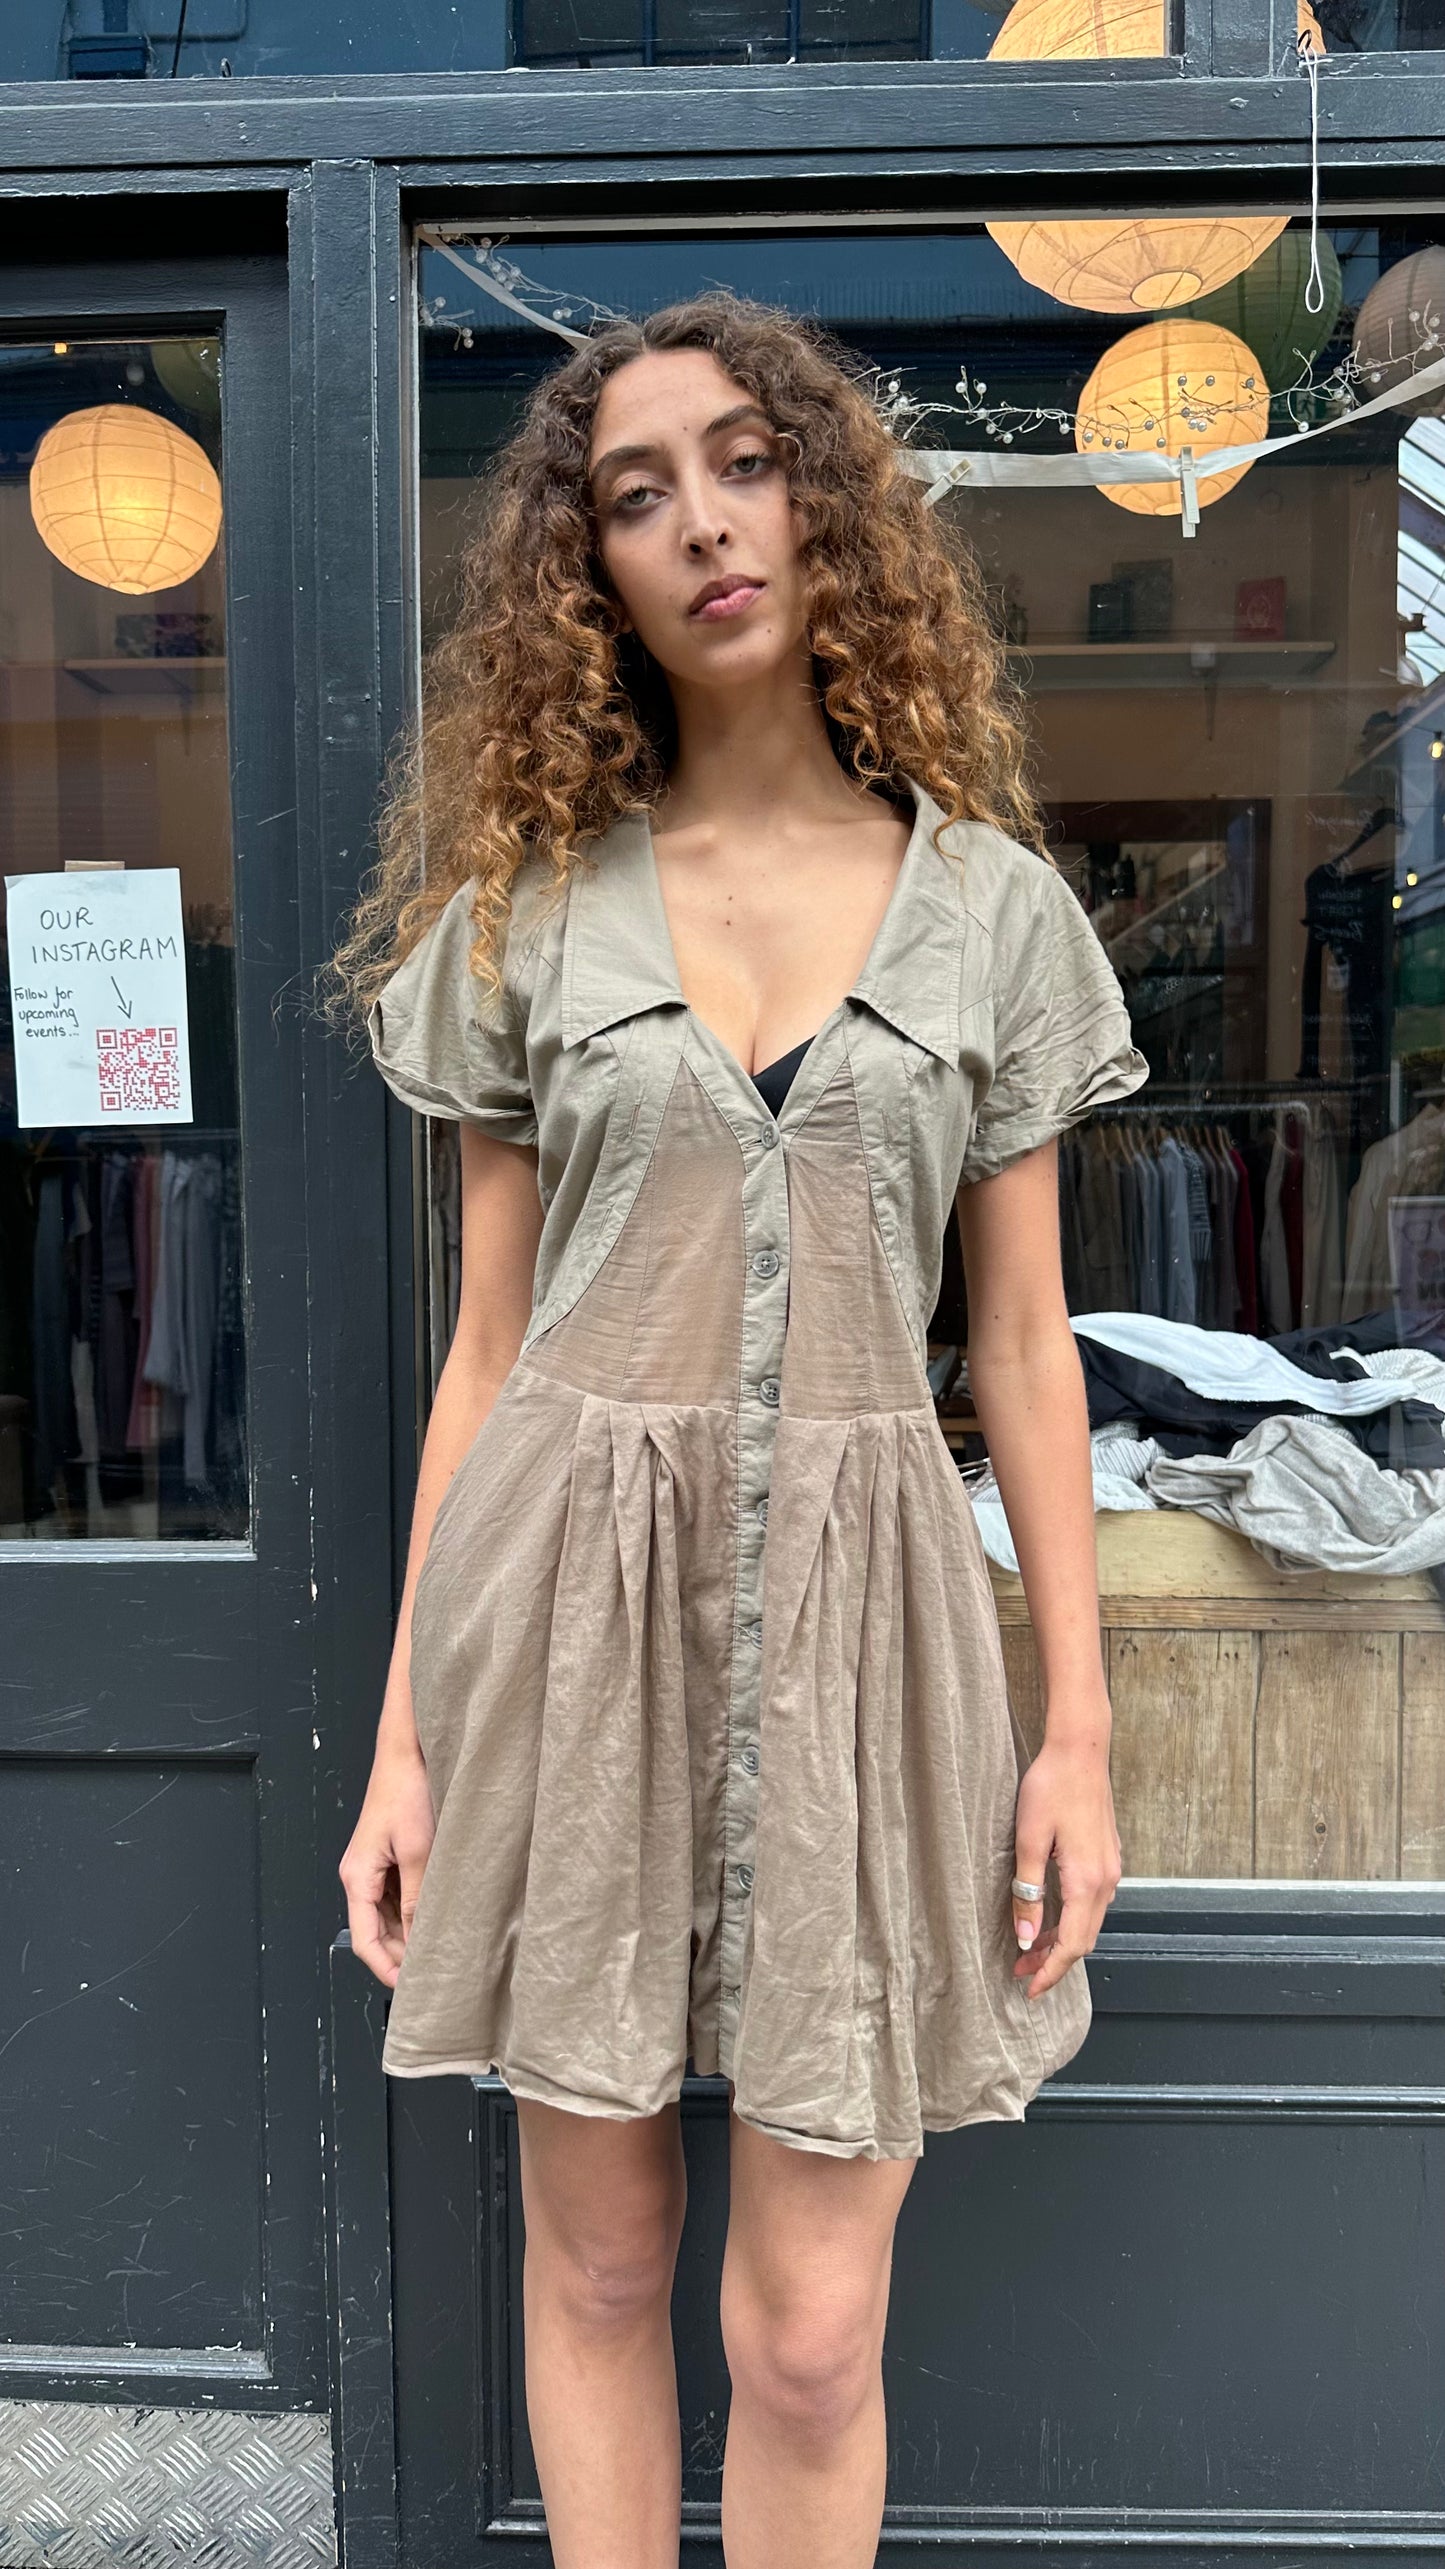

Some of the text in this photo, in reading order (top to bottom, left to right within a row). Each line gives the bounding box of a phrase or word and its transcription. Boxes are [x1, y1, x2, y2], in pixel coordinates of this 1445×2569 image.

[40, 907, 93, 930] OUR
[32, 937, 177, 964] INSTAGRAM
[14, 986, 73, 1009] Follow for
[18, 1008, 79, 1027] upcoming
